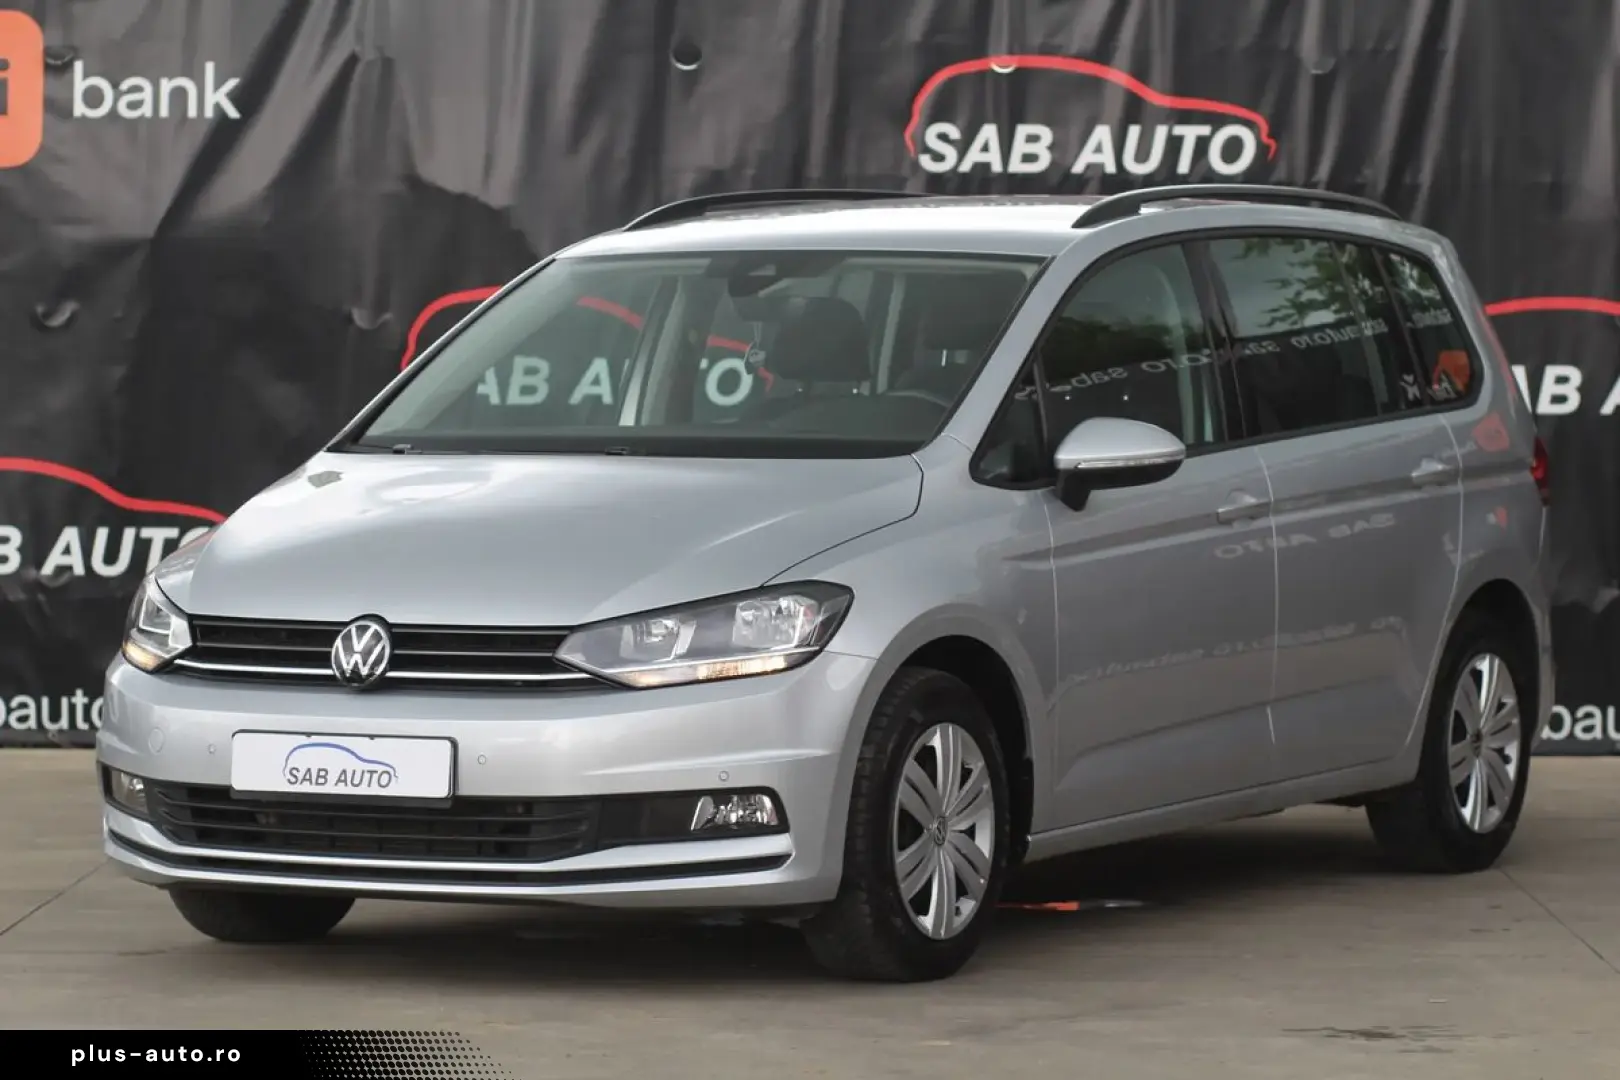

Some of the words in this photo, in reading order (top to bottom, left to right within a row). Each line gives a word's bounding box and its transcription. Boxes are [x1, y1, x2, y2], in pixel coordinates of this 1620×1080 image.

[73, 60, 241, 119] bank
[918, 122, 1053, 174] SAB
[1070, 123, 1257, 175] AUTO
[477, 355, 550, 406] AB
[0, 688, 104, 731] aut
[286, 766, 329, 786] SAB
[334, 768, 393, 789] AUTO
